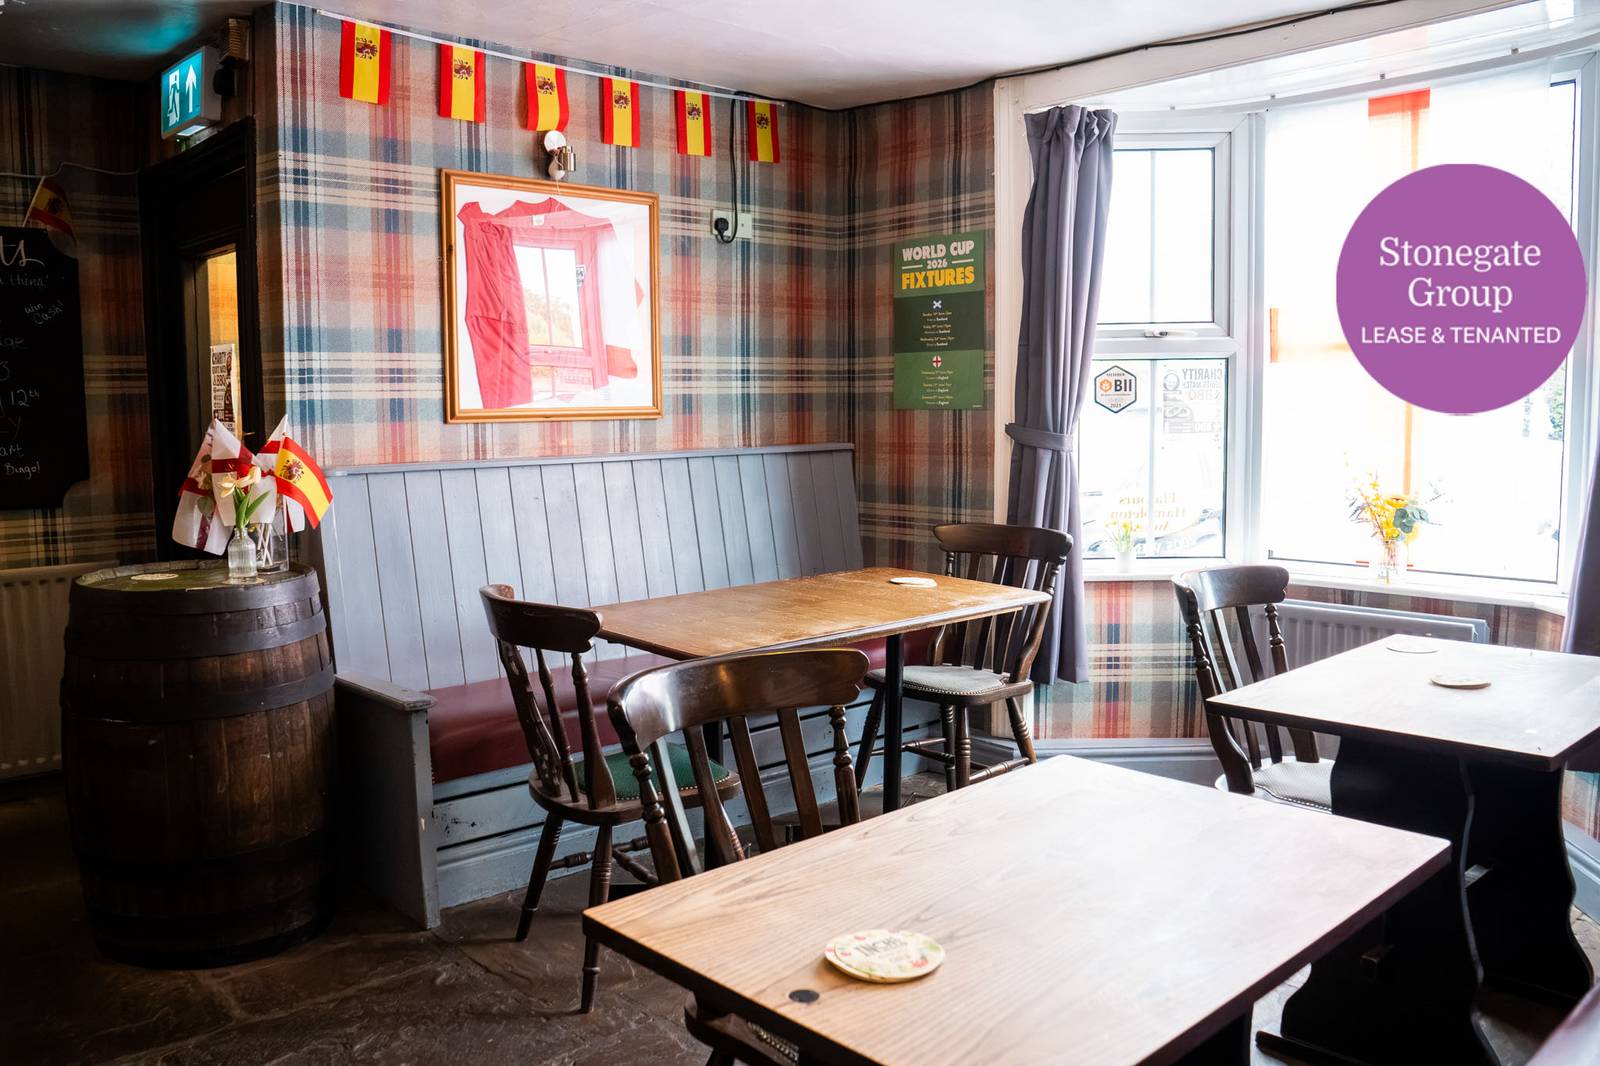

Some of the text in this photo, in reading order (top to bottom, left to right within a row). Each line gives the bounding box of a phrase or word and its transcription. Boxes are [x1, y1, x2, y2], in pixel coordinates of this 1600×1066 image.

[902, 240, 975, 261] WORLD CUP
[926, 259, 948, 269] 2026
[901, 266, 975, 289] FIXTURES
[1114, 379, 1132, 392] BII
[4, 460, 41, 479] Bingo!
